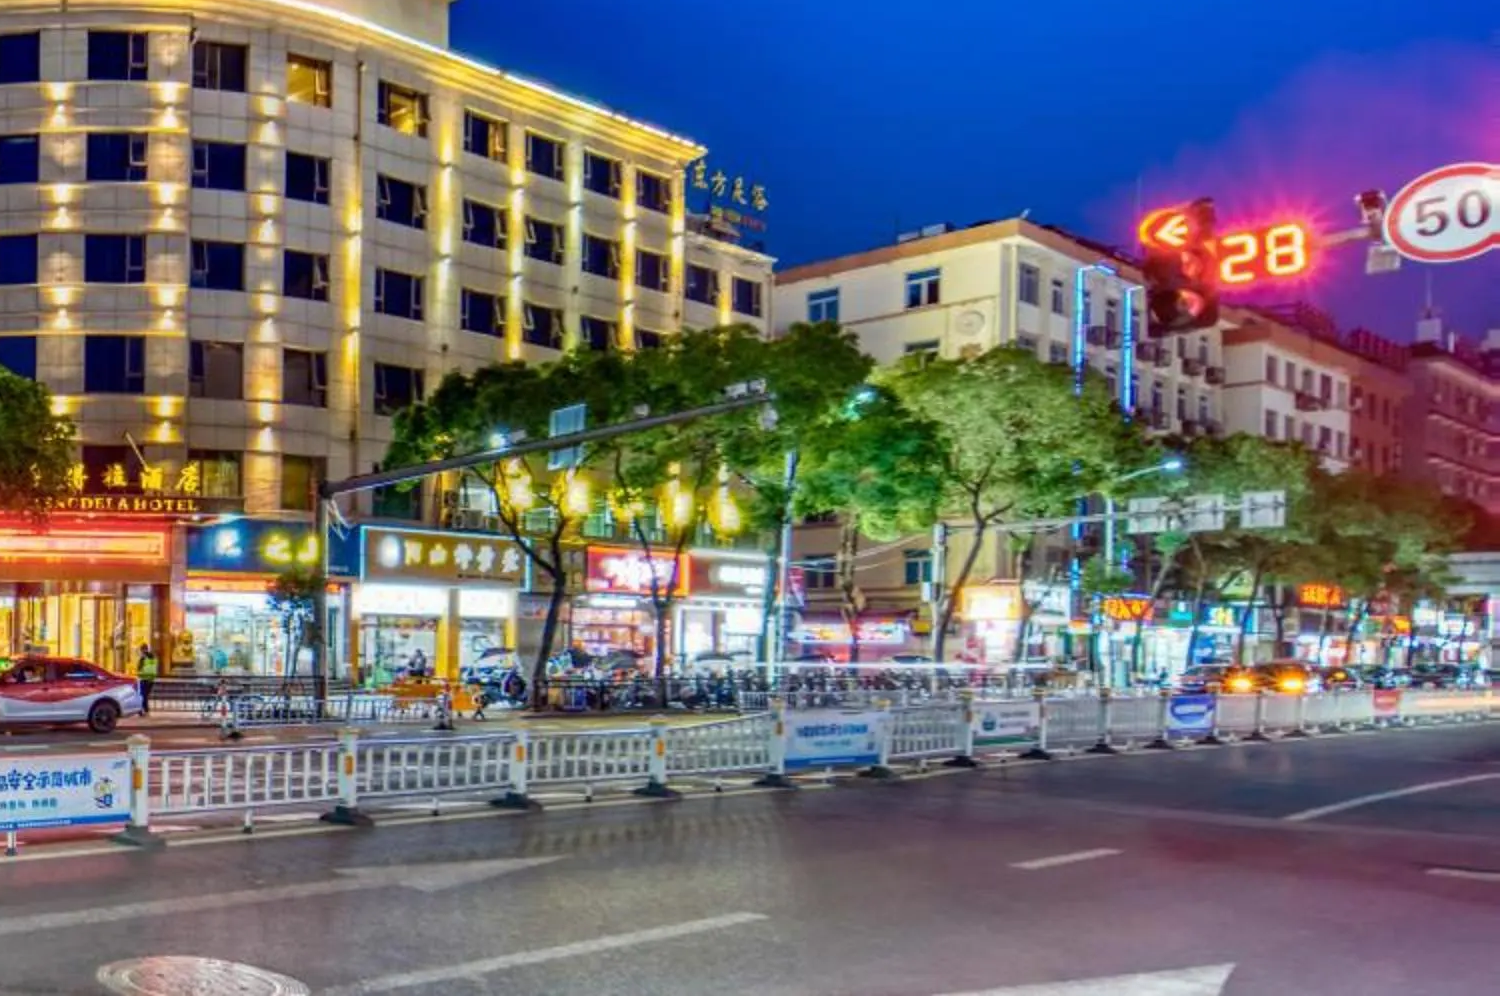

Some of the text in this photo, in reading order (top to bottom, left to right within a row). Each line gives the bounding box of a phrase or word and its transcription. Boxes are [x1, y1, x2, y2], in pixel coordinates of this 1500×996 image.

[1415, 189, 1492, 237] 50
[1218, 222, 1306, 284] 28
[30, 462, 200, 494] 得拉酒店
[134, 497, 198, 512] HOTEL
